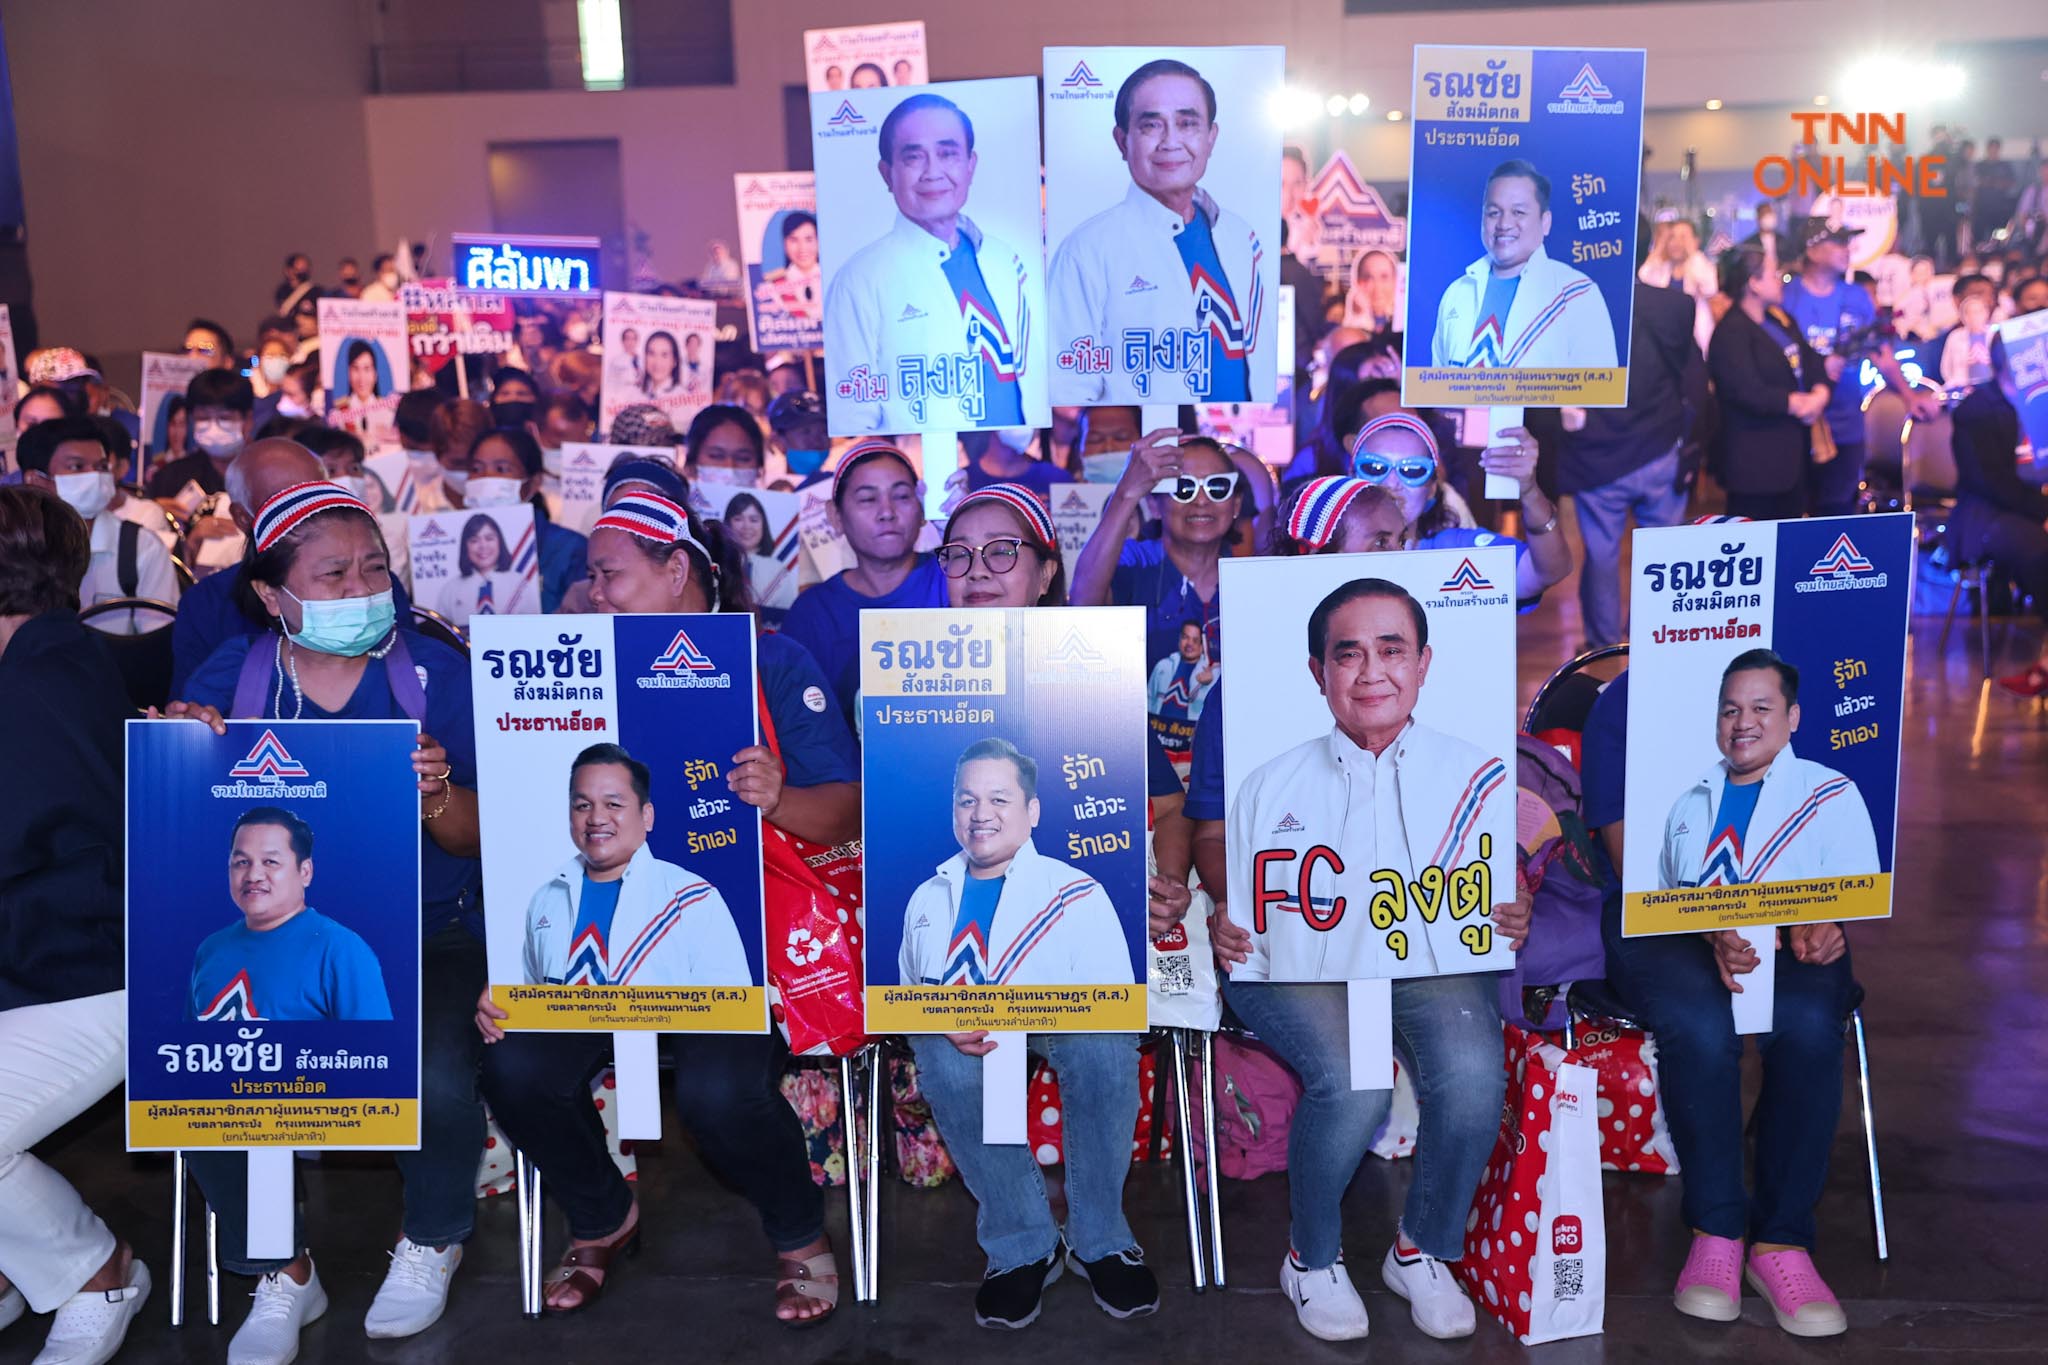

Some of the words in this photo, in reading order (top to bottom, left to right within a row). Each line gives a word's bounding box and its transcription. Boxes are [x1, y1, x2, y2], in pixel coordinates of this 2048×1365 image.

[1423, 59, 1521, 99] รณชัย
[1446, 101, 1520, 120] สังฆมิตกล
[1571, 174, 1607, 205] รู้จัก
[1578, 209, 1622, 231] แล้วจะ
[1571, 239, 1624, 263] รักเอง
[1056, 337, 1112, 375] #ทีม
[1121, 292, 1213, 400] ลุงตู่
[836, 364, 890, 402] #ทีม
[896, 317, 988, 426] ลุงตู่
[1643, 542, 1763, 592] รณชัย
[1795, 574, 1888, 594] รวมไทยสร้างชาติ
[1425, 594, 1509, 609] รวมไทยสร้างชาติ
[1672, 591, 1761, 612] สังฆมิตกล
[482, 633, 602, 679] รณชัย
[871, 624, 993, 670] รณชัย
[636, 673, 731, 689] รวมไทยสร้างชาติ
[901, 672, 993, 693] สังฆมิตกล
[1833, 658, 1868, 689] รู้จัก
[513, 681, 604, 700] สังฆมิตกล
[875, 701, 995, 725] ประธานอ๊อด
[1834, 695, 1876, 717] แล้วจะ
[1830, 723, 1879, 750] รักเอง
[684, 759, 719, 790] รู้จัก
[1062, 754, 1106, 790] รู้จัก
[211, 780, 327, 798] รวมไทยสร้างชาติ
[688, 799, 731, 820] แล้วจะ
[1073, 796, 1127, 821] แล้วจะ
[687, 828, 738, 854] รักเอง
[1067, 830, 1131, 859] รักเอง
[1253, 844, 1347, 935] FC
[1369, 832, 1492, 960] ลุงตู่
[1642, 881, 1836, 906] ผู้สมัครสมาชิกสภาผู้แทนราษฎร
[1839, 877, 1875, 891] (ส.ส.)
[508, 987, 707, 1003] ผู้สมัครสมาชิกสภาผู้แทนราษฎร
[712, 988, 748, 1002] (ส.ส.)
[884, 990, 1087, 1004] ผู้สมัครสมาชิกสภาผู้แทนราษฎร
[1093, 989, 1129, 1002] (ส.ส.)
[922, 1004, 994, 1014] เขตลาดกระบัง
[1007, 1004, 1092, 1015] กรุงเทพมหานคร
[157, 1027, 282, 1072] รณชัย
[295, 1049, 389, 1070] สังฆมิตกล
[231, 1076, 327, 1094] ประธานอ๊อด
[148, 1104, 357, 1119] ผู้สมัครสมาชิกสภาผู้แทนราษฎร
[362, 1103, 400, 1117] (ส.ส.)
[188, 1119, 262, 1129] เขตลาดกระบัง
[275, 1119, 361, 1129] กรุงเทพมหานคร
[266, 1272, 279, 1284] M
